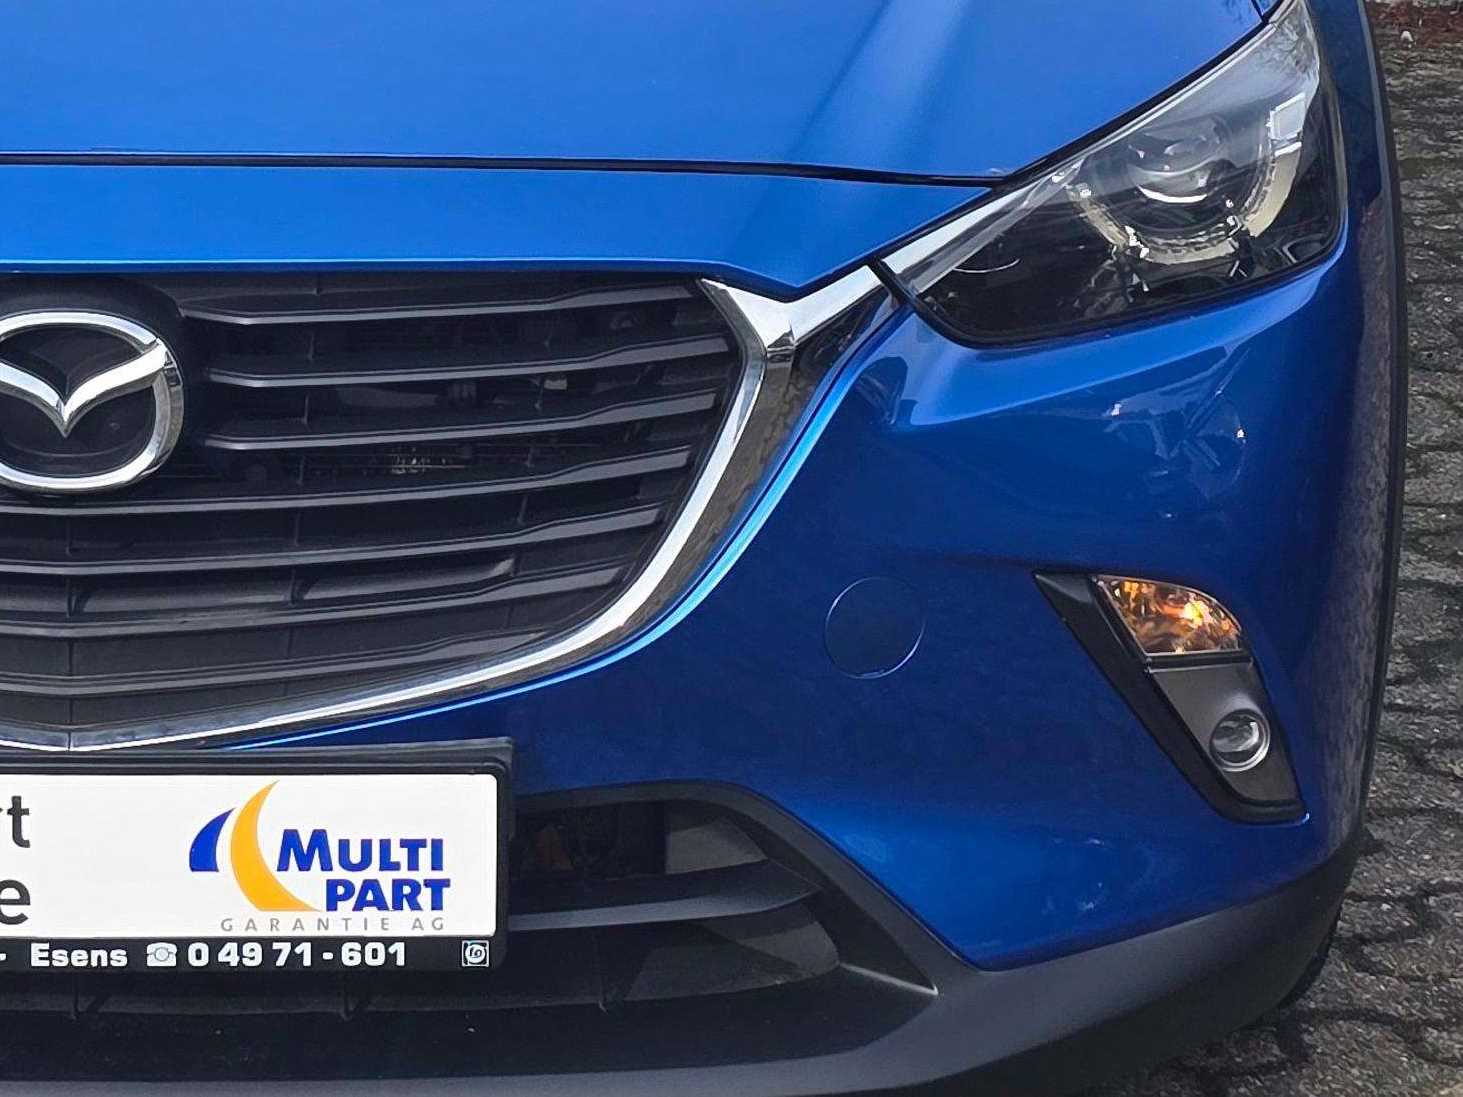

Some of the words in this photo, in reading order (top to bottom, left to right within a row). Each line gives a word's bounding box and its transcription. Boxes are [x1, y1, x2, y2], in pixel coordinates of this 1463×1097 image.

[277, 829, 443, 872] MULTI
[326, 879, 451, 912] PART
[221, 917, 391, 932] GARANTIE
[412, 917, 445, 931] AG
[31, 943, 128, 967] Esens
